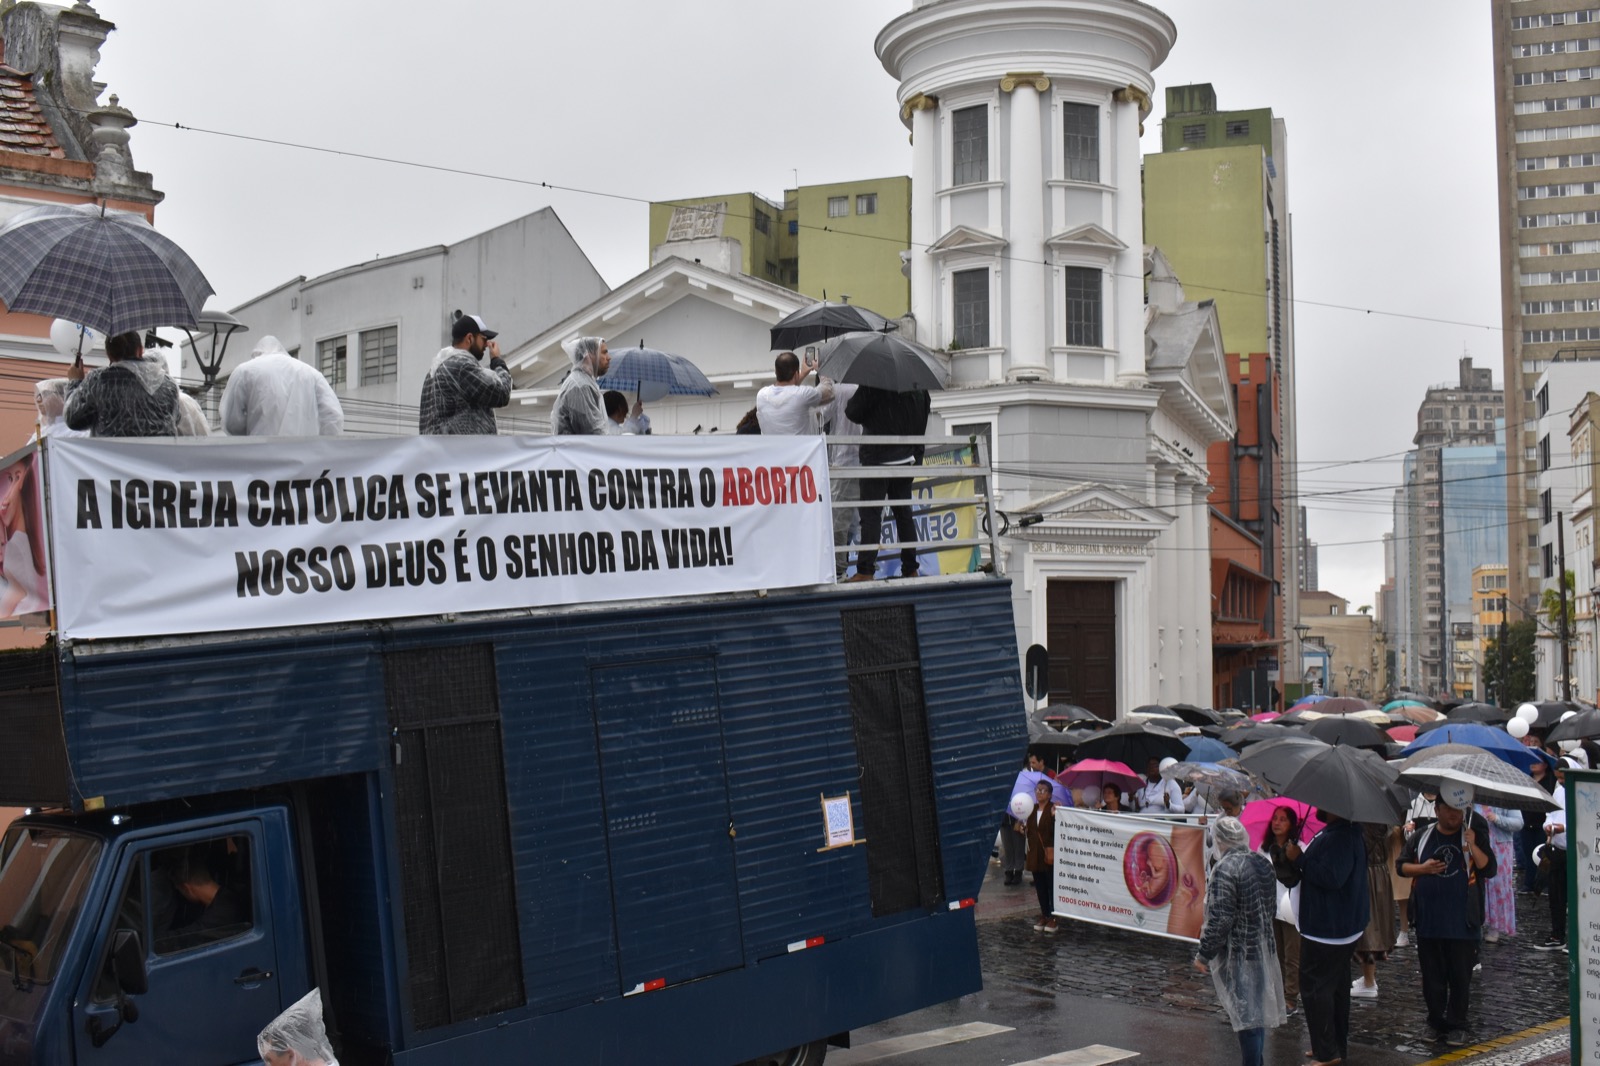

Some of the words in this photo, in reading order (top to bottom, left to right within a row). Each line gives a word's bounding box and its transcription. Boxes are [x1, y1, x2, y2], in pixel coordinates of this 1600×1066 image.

[76, 323, 94, 339] VDA!
[76, 478, 102, 529] A
[110, 478, 239, 530] IGREJA
[247, 470, 410, 528] CATÓLICA
[414, 473, 454, 518] SE
[460, 469, 584, 515] LEVANTA
[588, 467, 695, 511] CONTRA
[698, 467, 716, 508] O
[722, 464, 823, 508] ABORTO.
[235, 544, 356, 598] NOSSO
[361, 538, 447, 589] DEUS
[454, 530, 471, 582] É
[476, 536, 497, 581] O
[503, 531, 616, 579] SENHOR
[621, 529, 659, 572] DA
[661, 526, 734, 569] VIDA!
[1065, 821, 1084, 831] barriga
[1090, 826, 1114, 836] pequena,
[1067, 835, 1091, 844] semanas
[1100, 840, 1124, 849] gravidez
[1064, 846, 1074, 854] feto
[1080, 849, 1092, 857] bem
[1059, 858, 1076, 867] Somos
[1087, 863, 1106, 872] defesa
[1079, 874, 1094, 883] desde
[1059, 884, 1089, 896] concepção,
[1058, 895, 1077, 905] TODOS
[1078, 899, 1101, 910] CONTRA
[1108, 905, 1134, 917] ABORTO.
